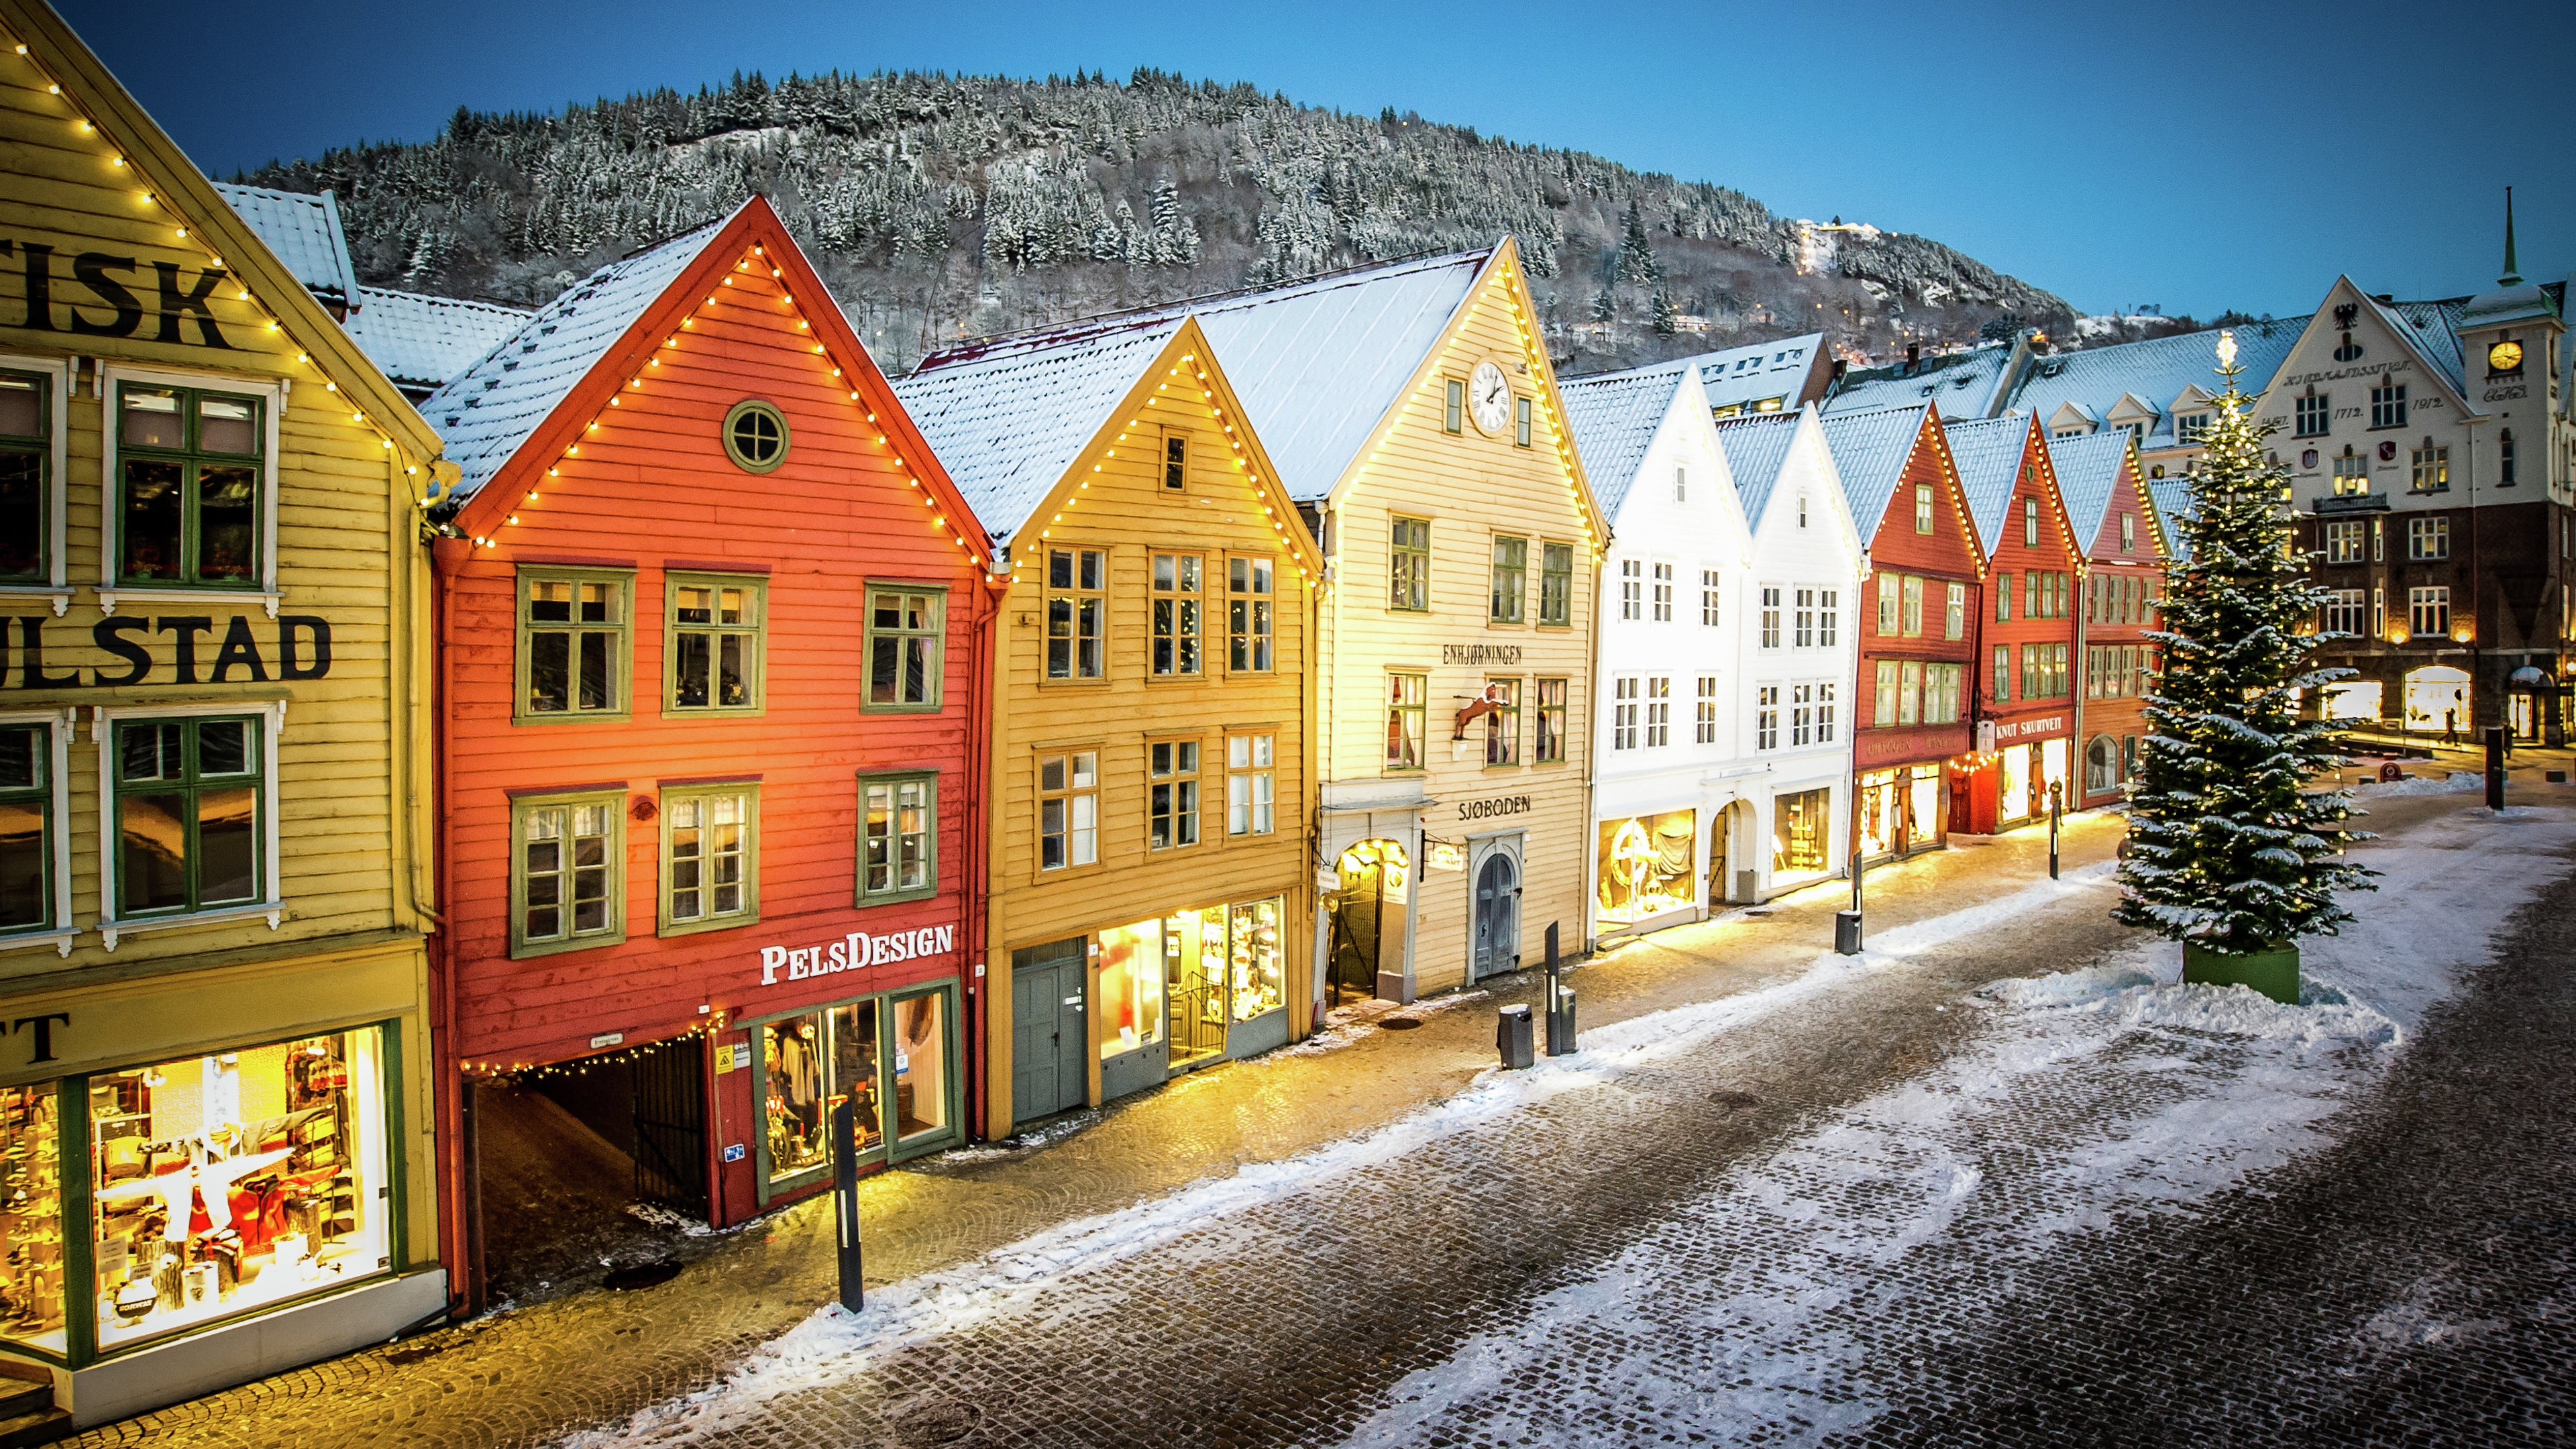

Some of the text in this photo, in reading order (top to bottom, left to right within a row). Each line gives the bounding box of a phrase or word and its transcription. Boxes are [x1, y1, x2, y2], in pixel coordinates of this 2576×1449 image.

[0, 239, 233, 350] ISK
[0, 615, 331, 690] LSTAD
[1443, 644, 1521, 665] ENHJØRNINGEN
[1996, 716, 2061, 739] KNUT SKURTVEIT
[1458, 795, 1530, 821] SJØBODEN
